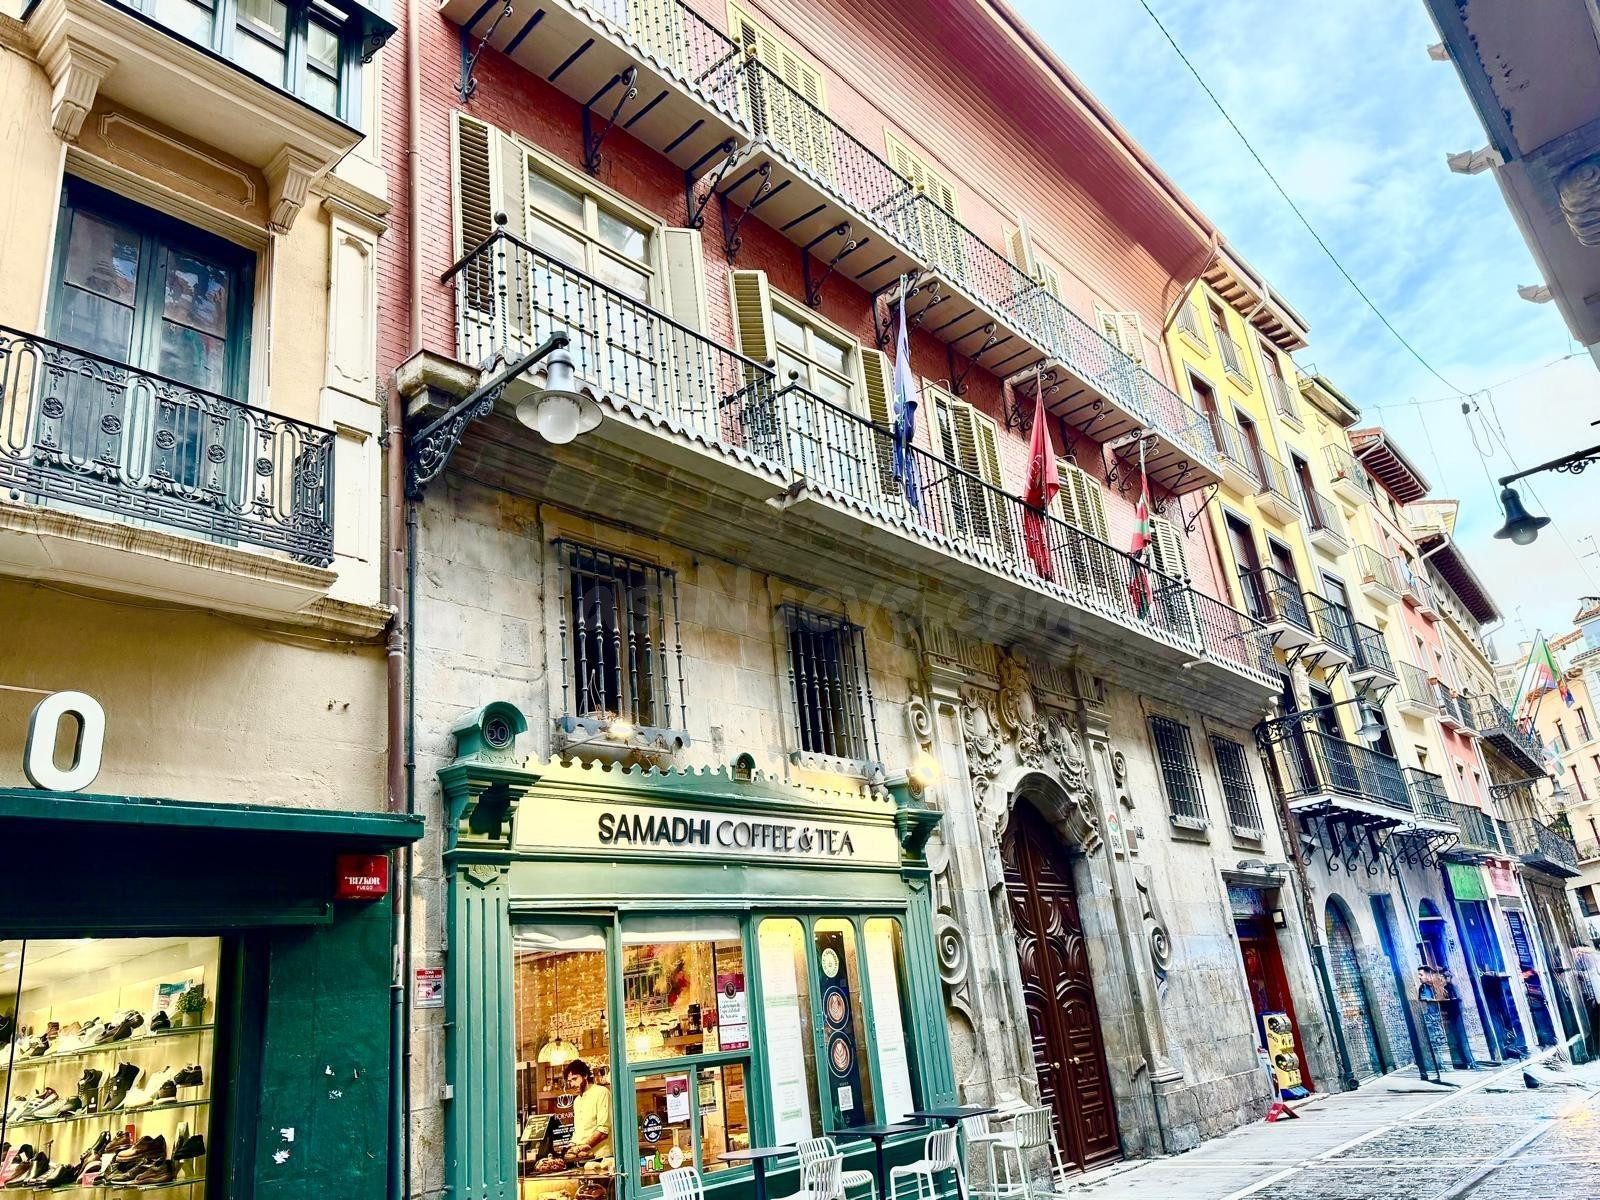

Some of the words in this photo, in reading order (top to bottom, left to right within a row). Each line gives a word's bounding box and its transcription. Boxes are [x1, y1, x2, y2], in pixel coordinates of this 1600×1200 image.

[598, 812, 711, 846] SAMADHI
[717, 820, 796, 852] COFFEE
[798, 826, 813, 852] &
[815, 828, 854, 856] TEA
